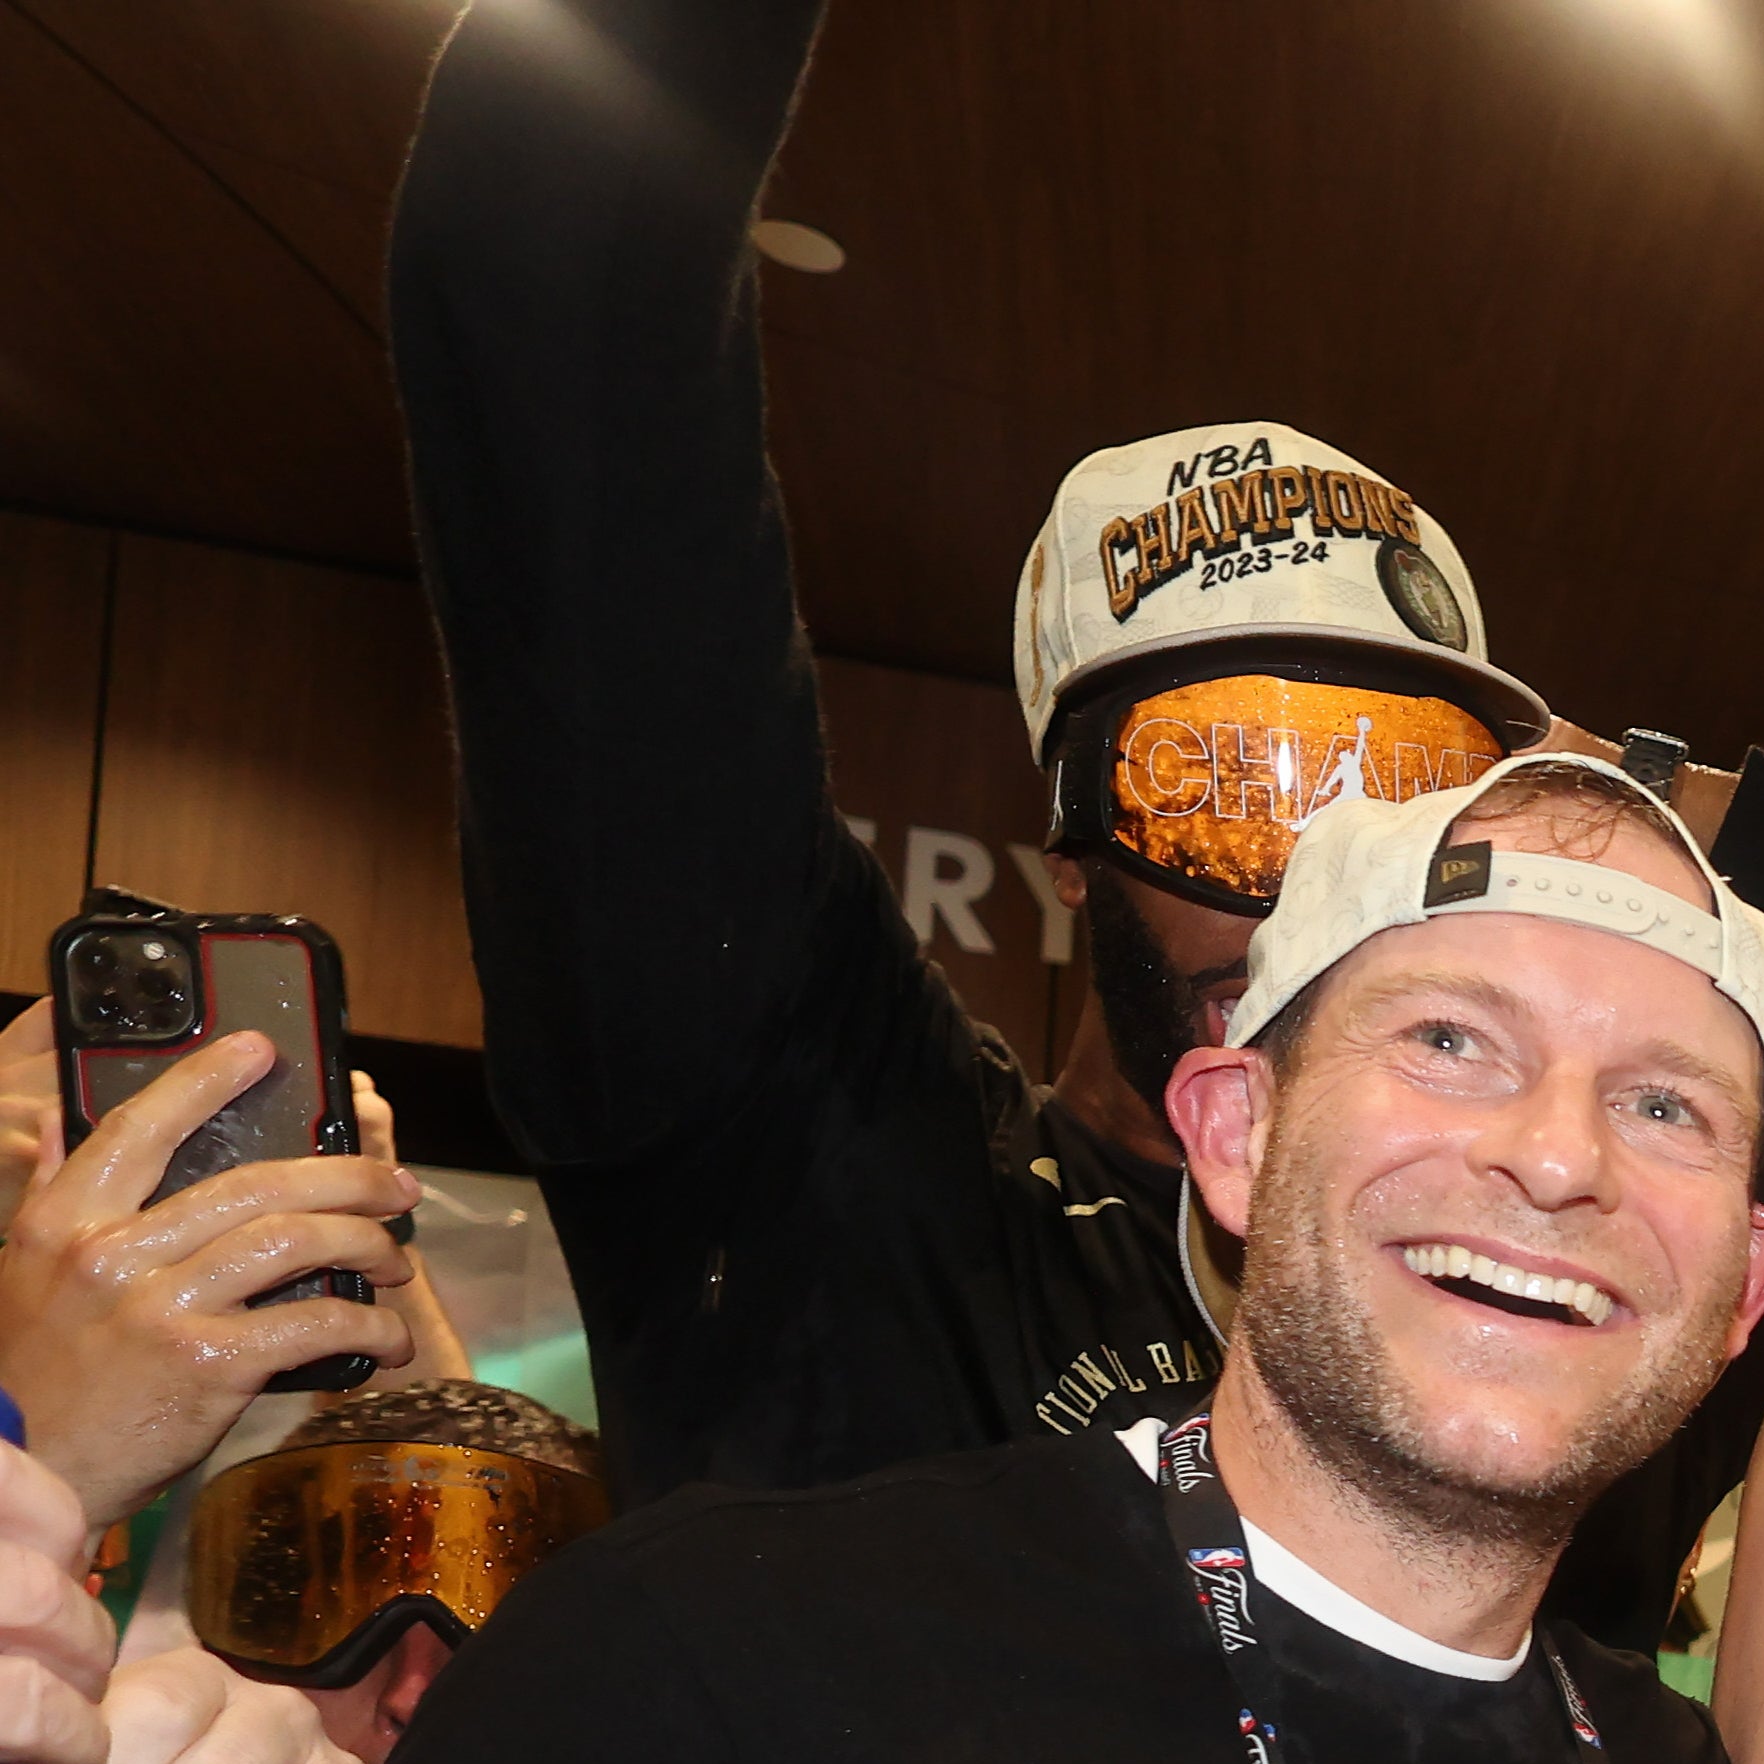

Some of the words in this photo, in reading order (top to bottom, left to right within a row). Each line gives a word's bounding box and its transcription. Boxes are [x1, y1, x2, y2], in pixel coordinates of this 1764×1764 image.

[1167, 437, 1273, 498] NBA
[1099, 464, 1422, 623] CHAMPIONS
[1199, 540, 1331, 591] 2023-24
[1186, 1557, 1258, 1655] Finals
